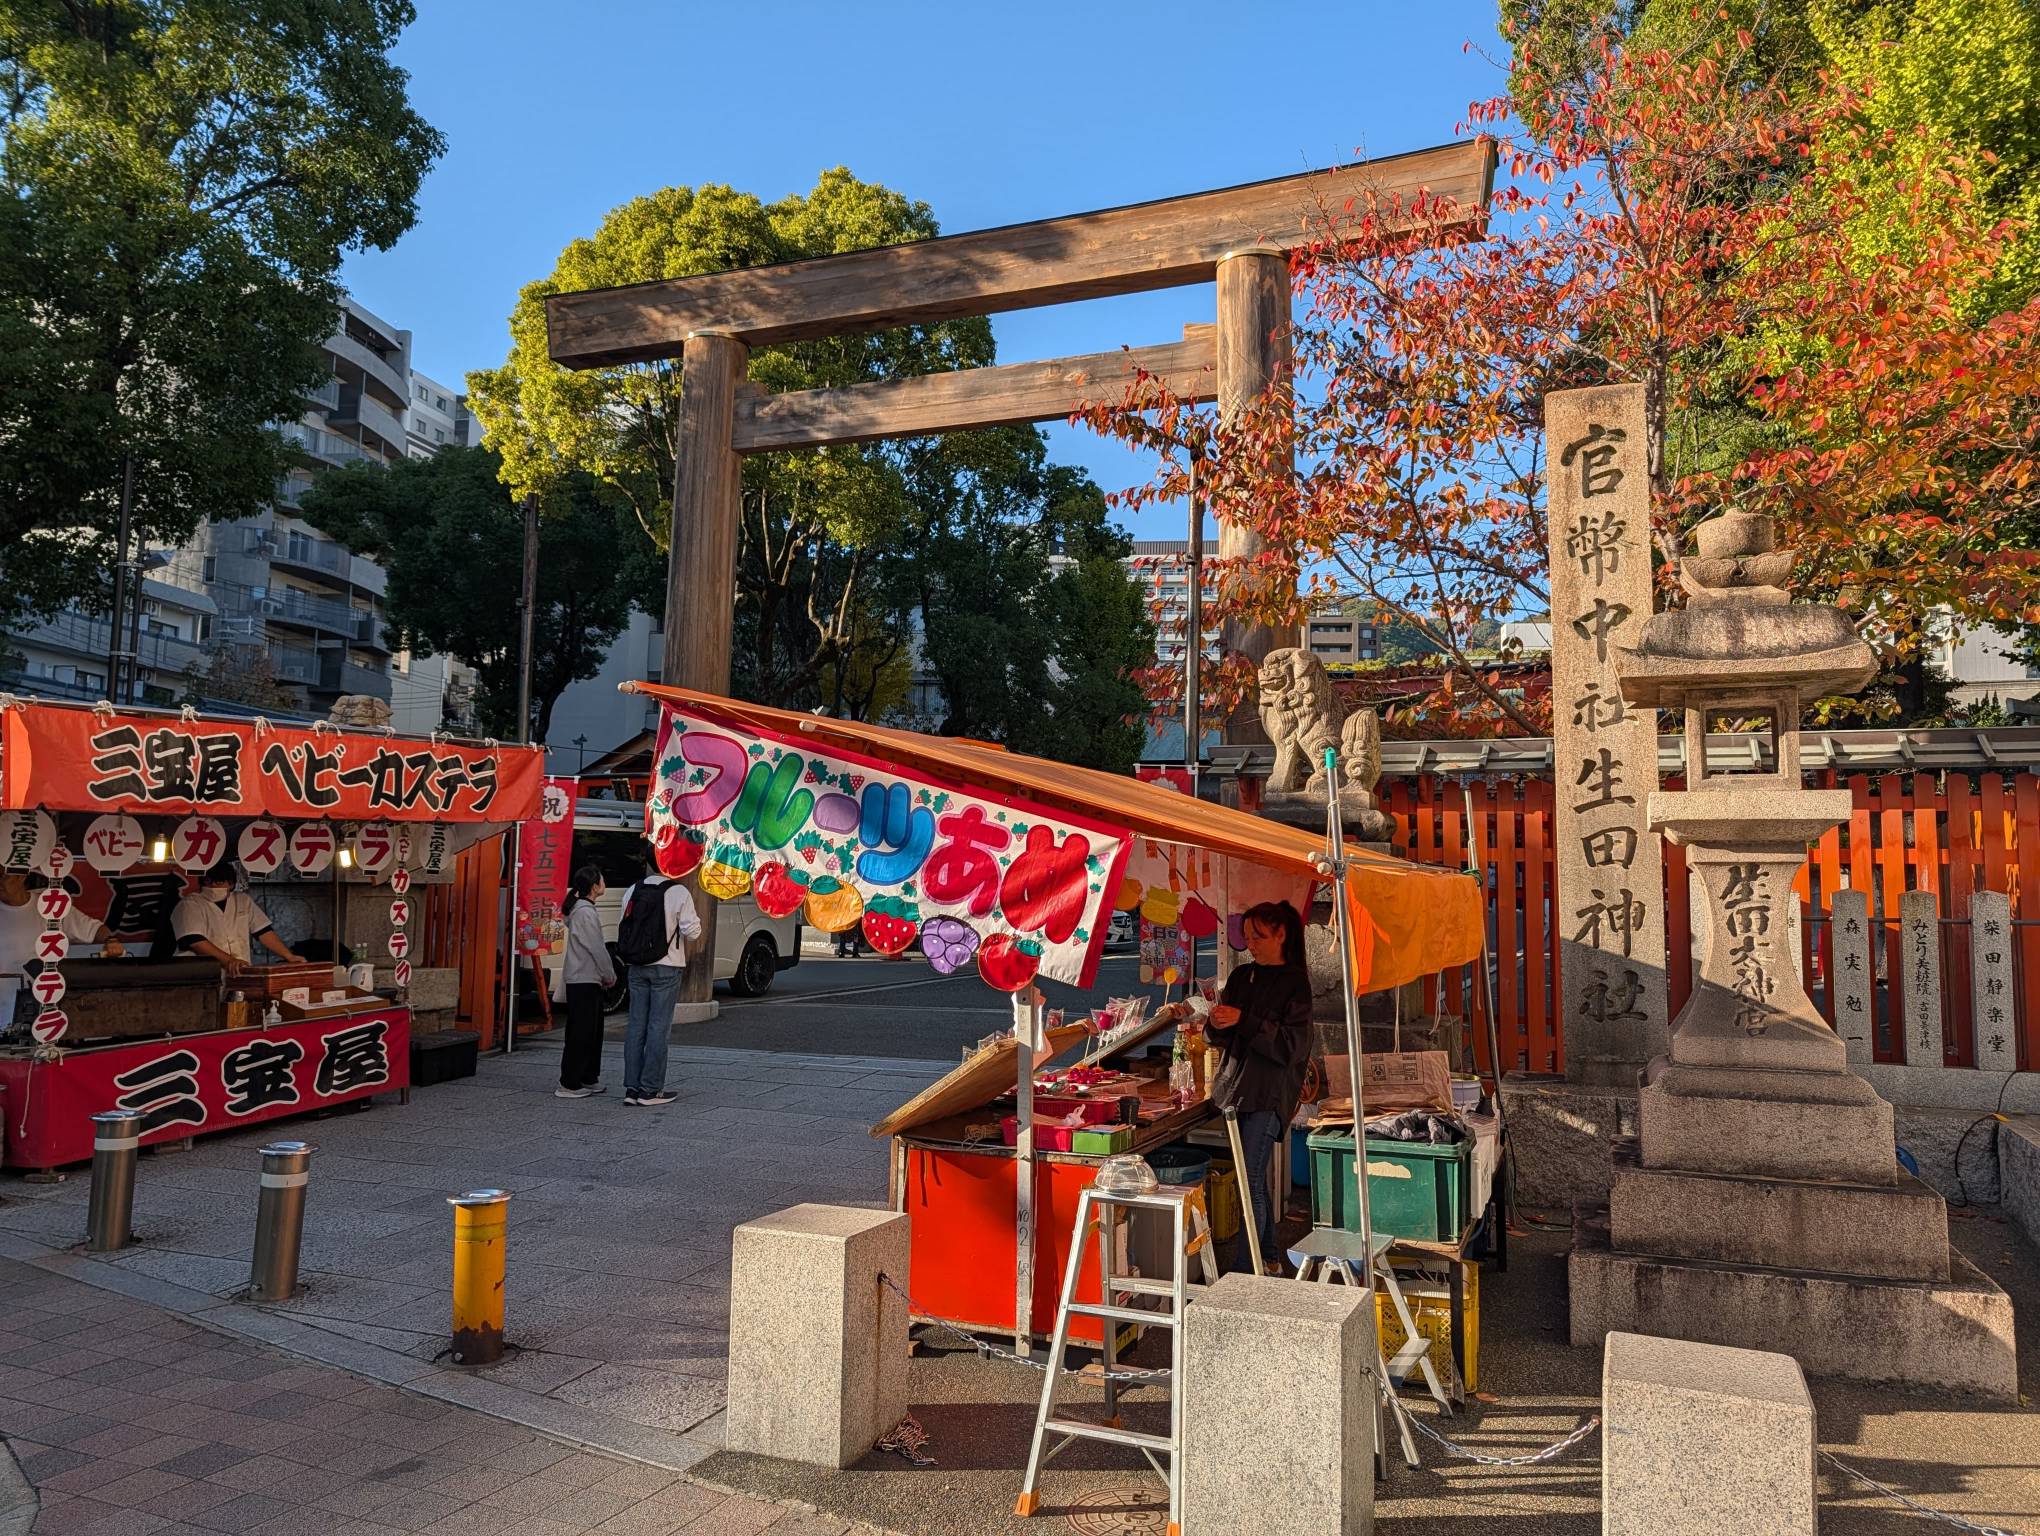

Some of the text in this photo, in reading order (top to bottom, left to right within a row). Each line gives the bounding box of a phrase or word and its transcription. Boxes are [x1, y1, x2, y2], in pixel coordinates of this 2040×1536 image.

[87, 725, 498, 813] 三宝屋 ベビーカステラ
[543, 796, 562, 817] 祝
[671, 730, 1091, 945] フルーツあめ
[115, 1021, 389, 1137] 三宝屋
